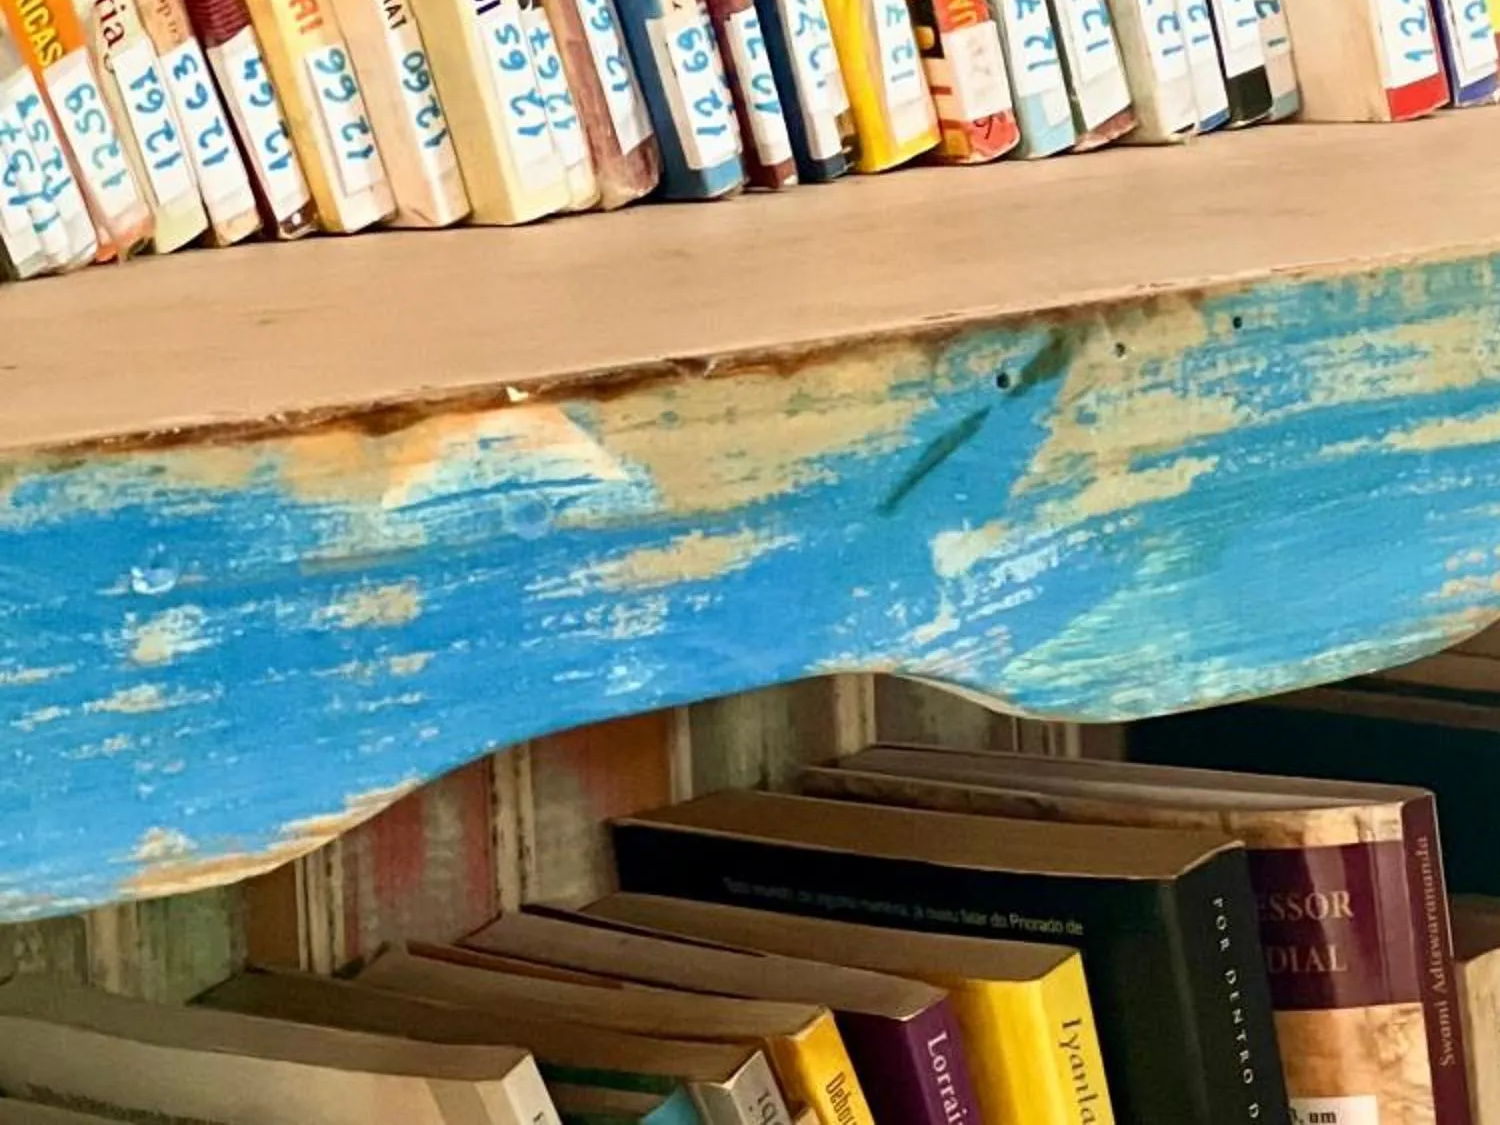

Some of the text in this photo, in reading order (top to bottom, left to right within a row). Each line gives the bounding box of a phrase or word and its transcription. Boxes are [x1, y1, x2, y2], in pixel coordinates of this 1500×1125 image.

[1212, 896, 1230, 953] POR
[1225, 970, 1255, 1087] DENTRO
[1438, 989, 1457, 1068] Swami
[1308, 1110, 1337, 1124] um
